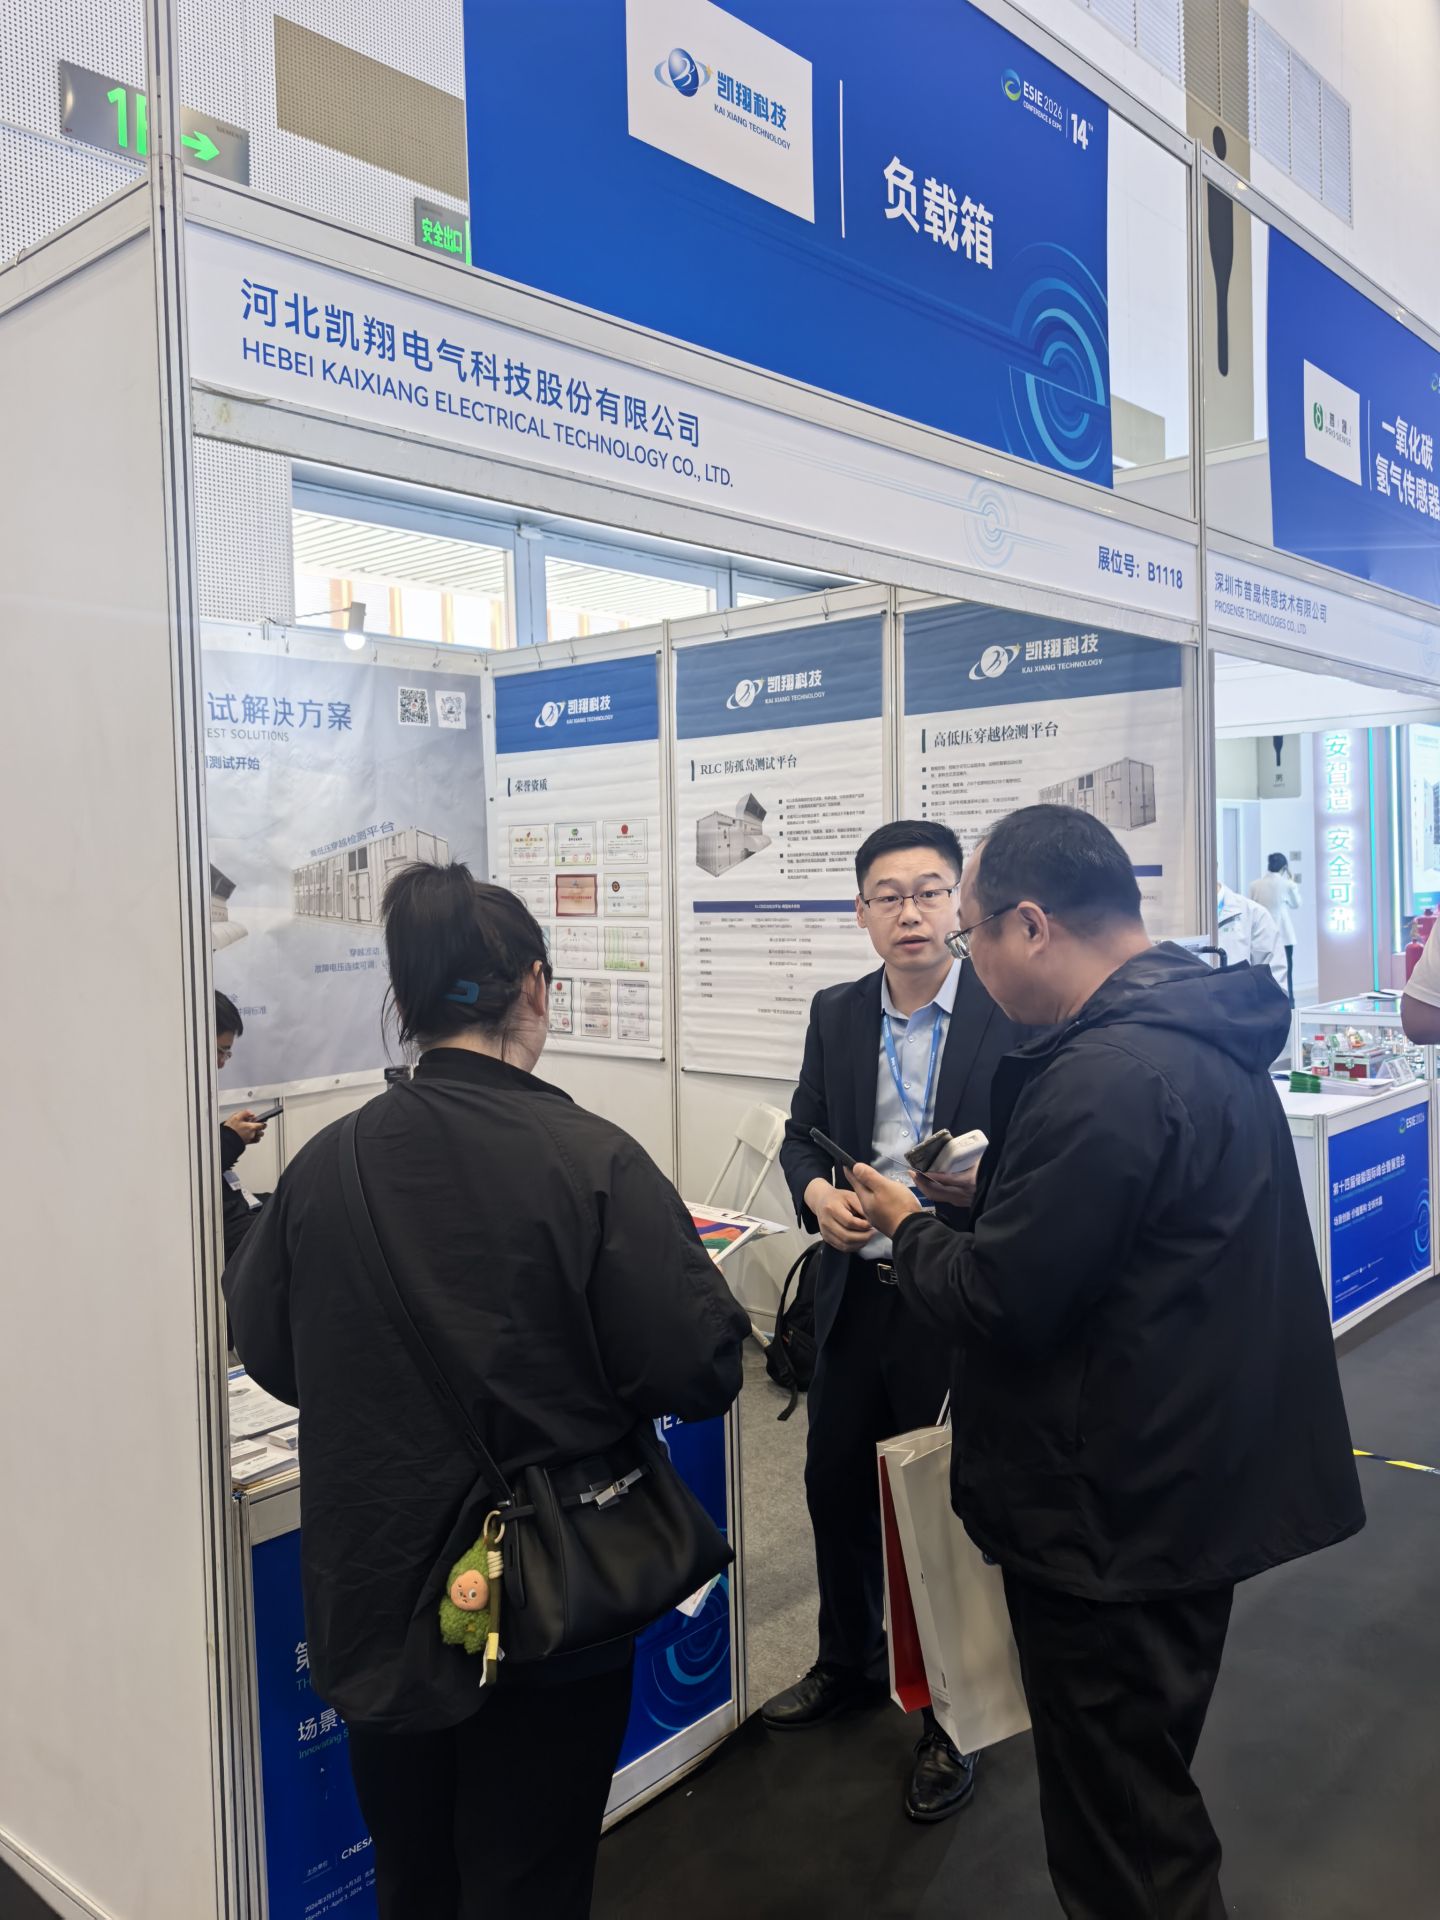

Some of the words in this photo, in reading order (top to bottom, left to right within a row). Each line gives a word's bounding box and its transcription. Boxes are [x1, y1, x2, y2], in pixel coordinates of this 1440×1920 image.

[717, 70, 787, 131] 凯翔科技
[714, 103, 726, 116] KAI
[726, 110, 748, 128] XIANG
[749, 122, 791, 150] TECHNOLOGY
[883, 156, 994, 269] 负载箱
[422, 217, 463, 253] 安全出口
[240, 278, 700, 448] 河北凯翔电气科技股份有限公司
[242, 337, 314, 378] HEBEI
[322, 360, 430, 408] KAIXIANG
[435, 391, 550, 440] ELECTRICAL
[553, 423, 668, 471] TECHNOLOGY
[705, 464, 734, 488] LTD.
[1382, 416, 1433, 472] 一氧化碳
[1375, 453, 1440, 521] 氢气传感器
[1147, 562, 1183, 590] B1118
[1215, 600, 1245, 618] PROSENSE
[1246, 608, 1286, 629] TECHNOLOGIES
[1025, 633, 1099, 661] 凯翔科技
[1022, 666, 1033, 674] KAI
[1034, 663, 1056, 673] XIANG
[1057, 658, 1103, 671] TECHNOLOGY
[767, 670, 822, 693] 凯翔科技
[567, 695, 611, 714] 凯翔科技
[791, 691, 825, 701] TECHNOLOGY
[207, 692, 352, 731] 试解决方案
[231, 728, 290, 742] SOLUTIONS
[934, 721, 1059, 748] 高低压穿越检测平台
[205, 756, 261, 770] 测试开始
[701, 763, 722, 775] RLC
[724, 754, 797, 774] 防孤岛测试平台
[515, 779, 548, 793] 荣誉资质
[298, 1707, 345, 1741] 场景
